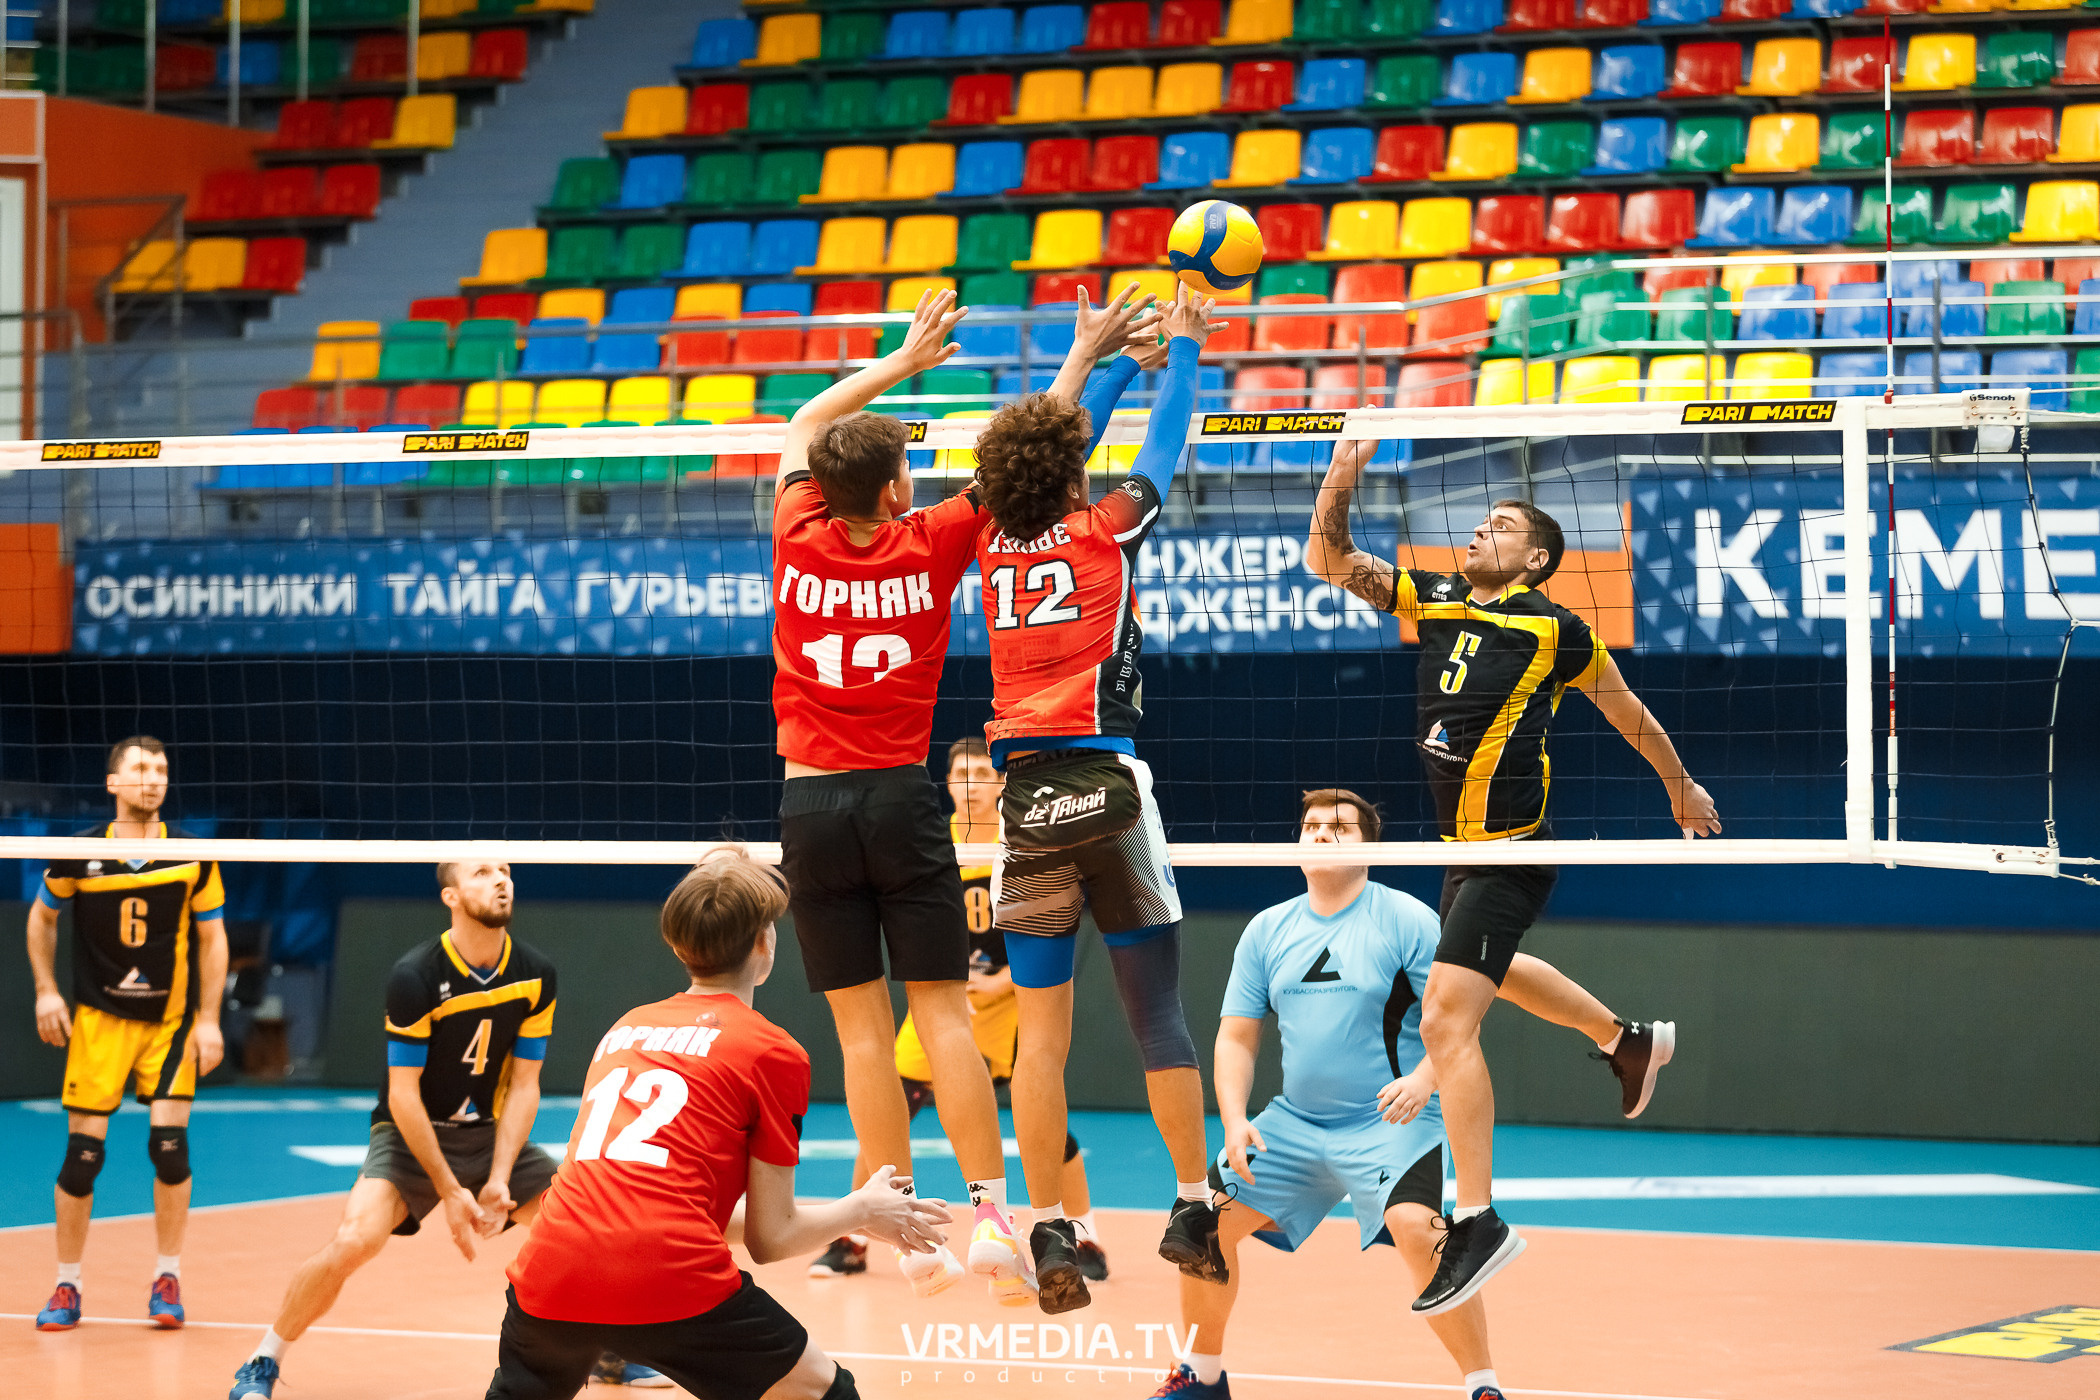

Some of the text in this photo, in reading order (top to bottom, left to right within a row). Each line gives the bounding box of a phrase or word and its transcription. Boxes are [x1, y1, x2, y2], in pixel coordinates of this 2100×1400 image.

[1684, 404, 1833, 422] PARI MATCH
[1977, 393, 2016, 402] Senoh
[405, 433, 528, 451] PARI MATCH
[1204, 415, 1343, 432] PARI MATCH
[43, 442, 160, 459] PARI MATCH
[1133, 533, 1319, 584] НЖЕР
[85, 573, 358, 619] ОСИННИКИ
[386, 558, 548, 618] ТАЙГА
[779, 563, 935, 619] ГОРНЯК
[989, 558, 1082, 631] 12
[1439, 630, 1483, 695] 5
[119, 896, 149, 948] 6
[963, 886, 991, 935] 8
[461, 1018, 493, 1076] 4
[594, 1025, 722, 1063] ГОРНЯК
[574, 1066, 690, 1169] 12
